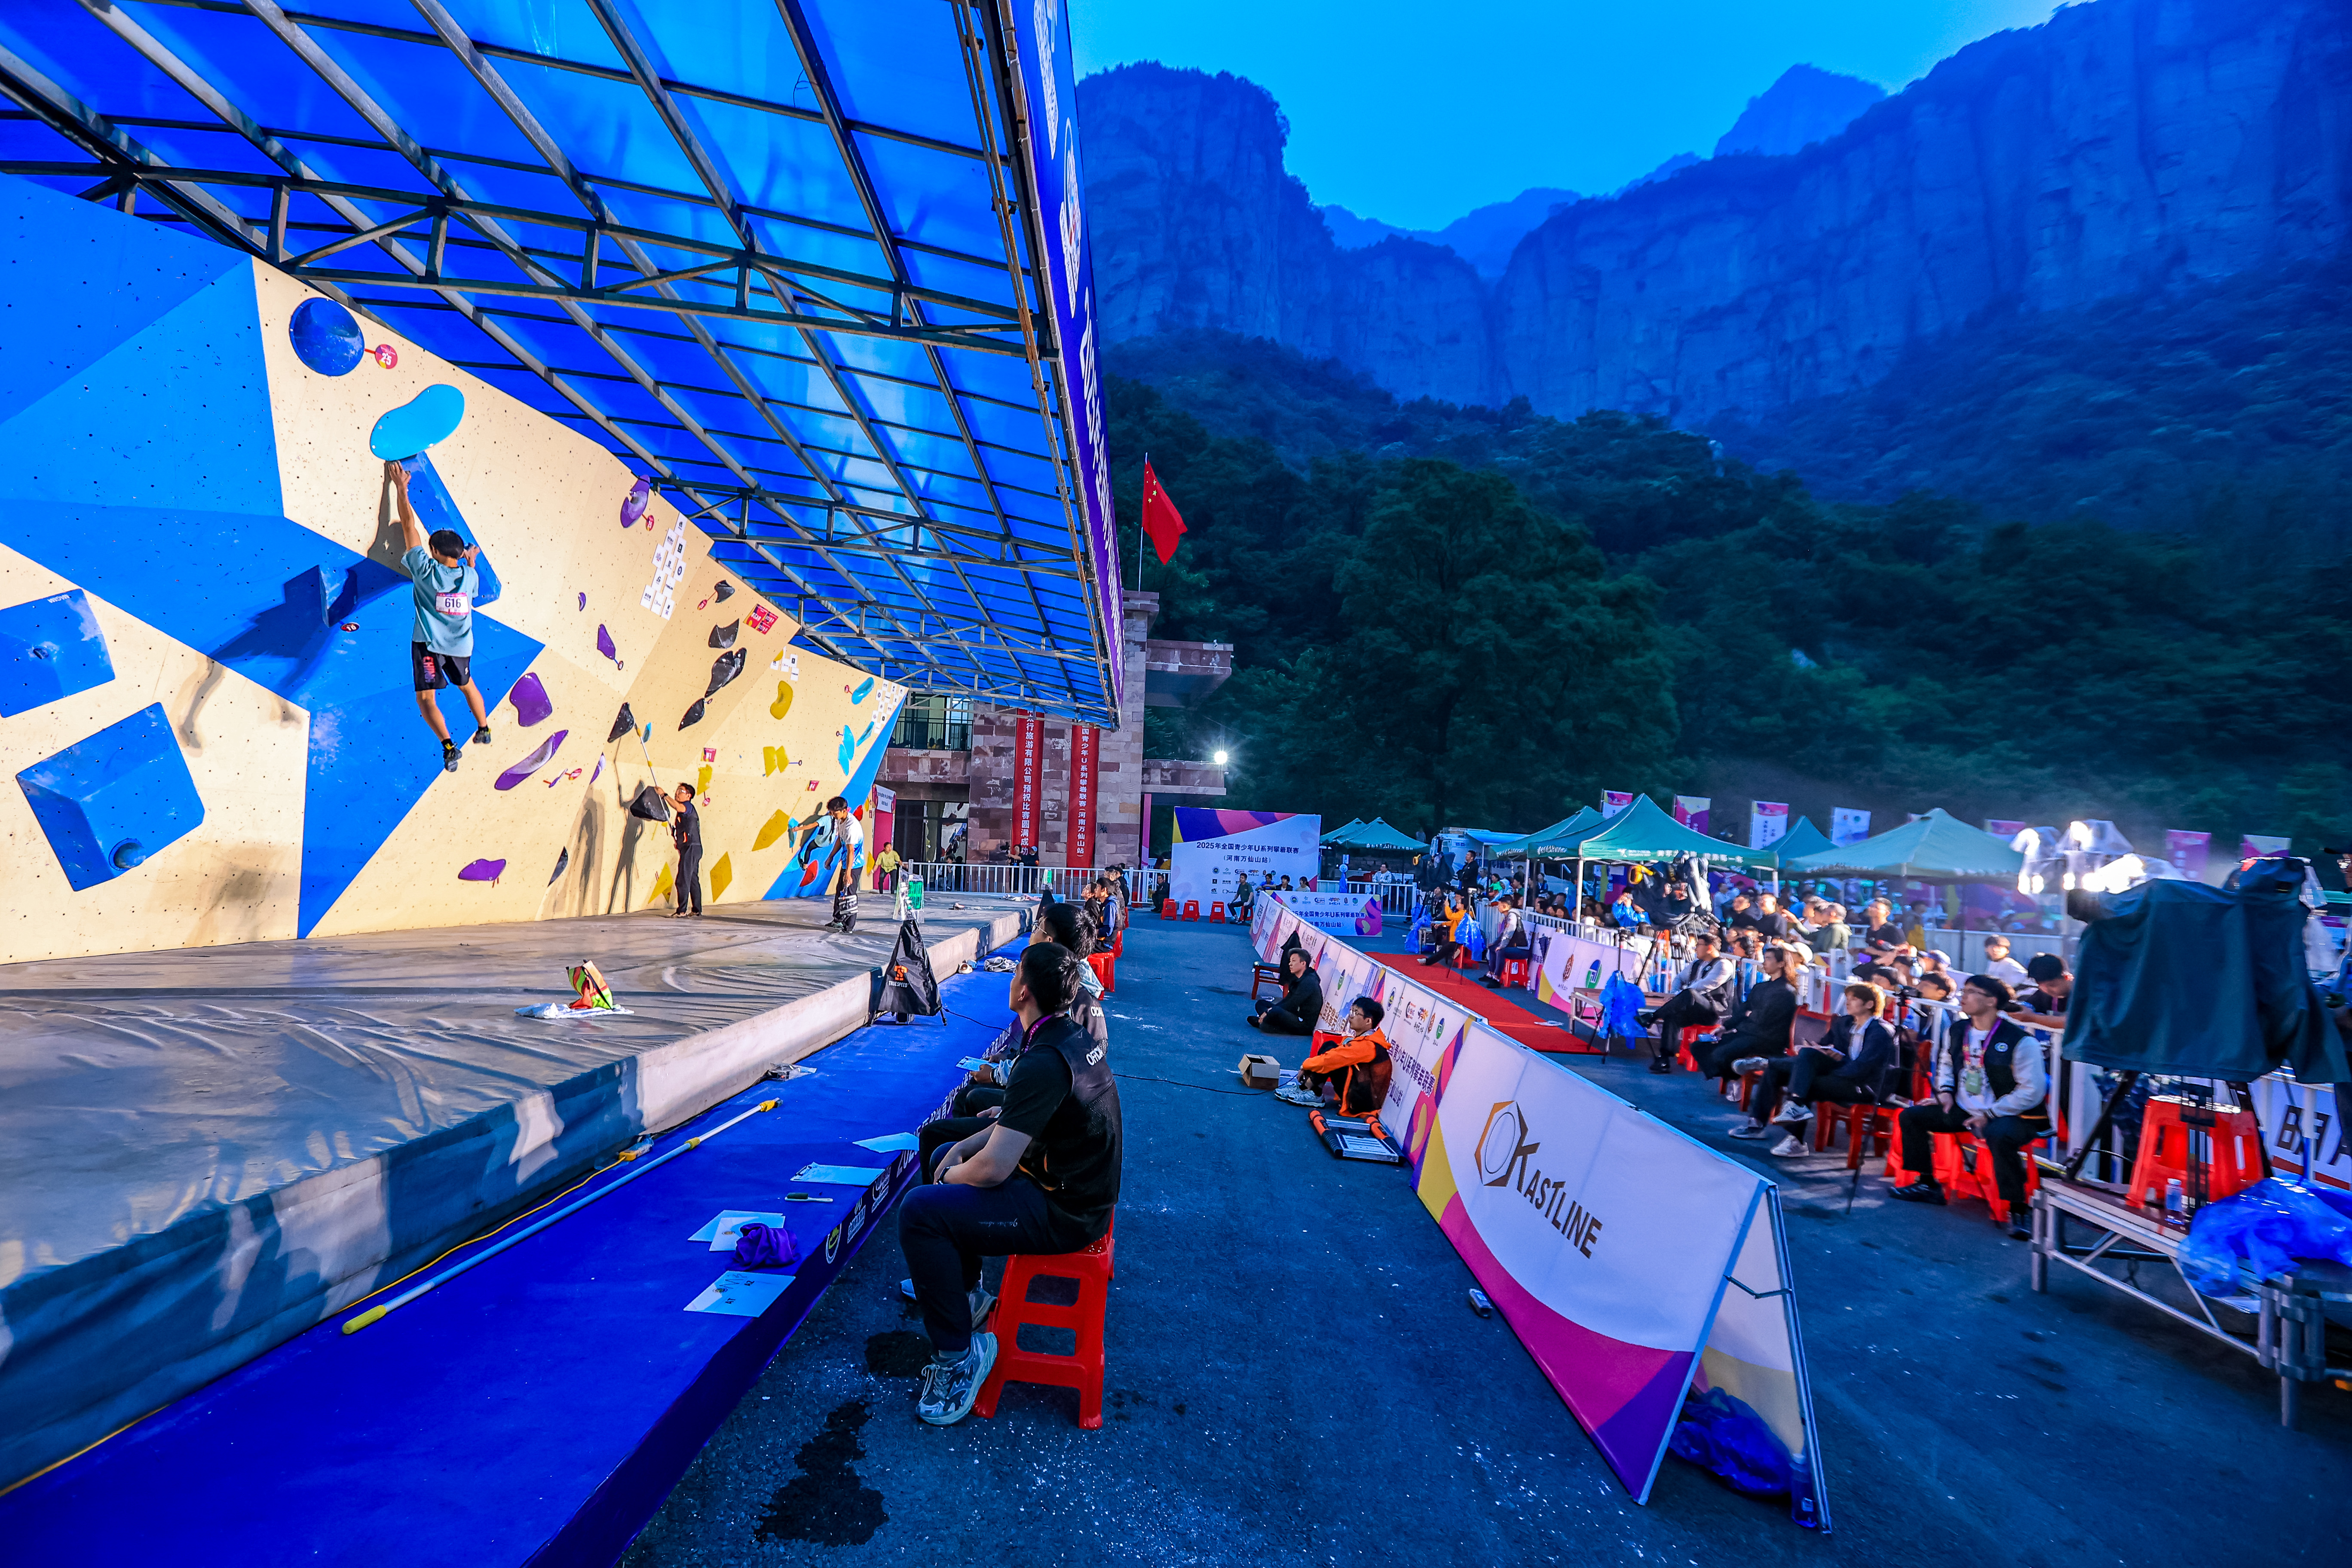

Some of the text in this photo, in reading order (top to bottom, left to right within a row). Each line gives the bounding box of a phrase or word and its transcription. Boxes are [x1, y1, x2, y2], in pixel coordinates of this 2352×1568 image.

[381, 352, 392, 365] 25
[445, 598, 461, 608] 616
[1196, 842, 1299, 854] 2025年全国青少年U系列攀岩联赛
